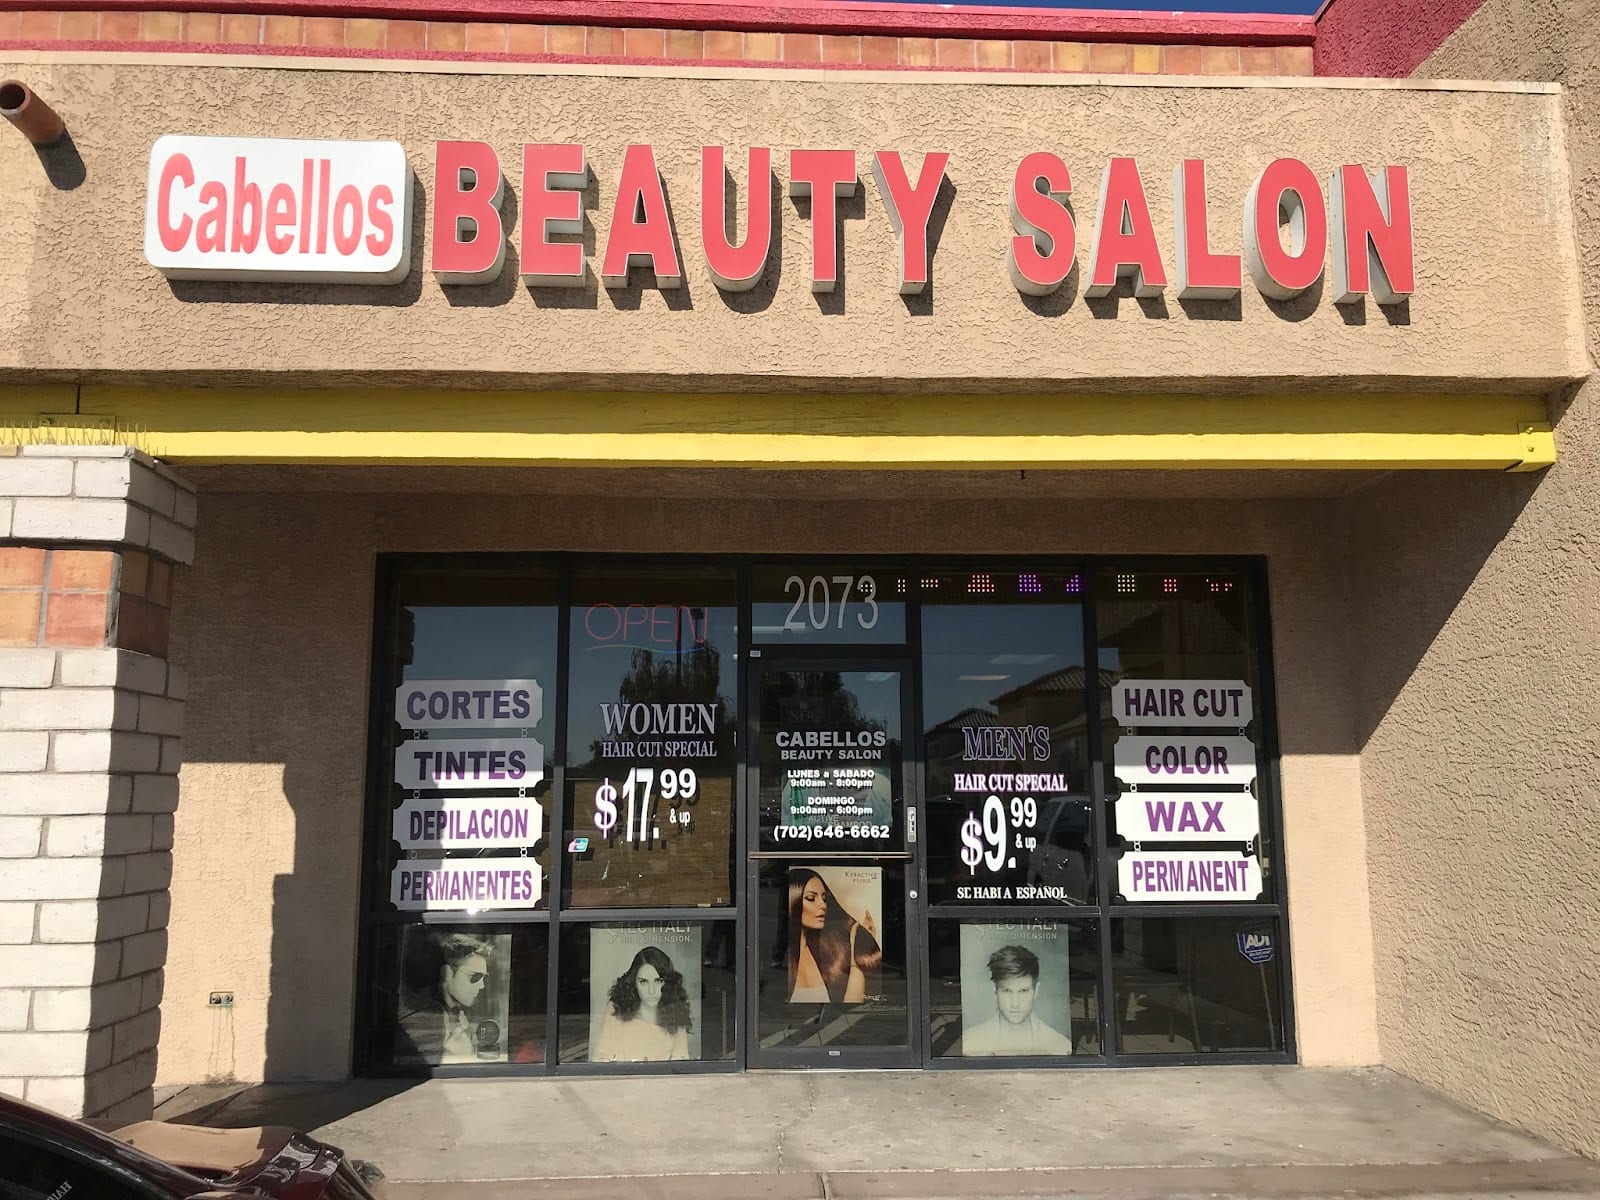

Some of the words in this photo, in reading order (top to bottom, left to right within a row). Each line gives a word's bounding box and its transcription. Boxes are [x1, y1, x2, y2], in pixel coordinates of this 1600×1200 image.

[156, 152, 395, 258] Cabellos
[431, 139, 950, 288] BEAUTY
[1010, 151, 1415, 297] SALON
[784, 575, 879, 630] 2073
[584, 603, 709, 644] OPEN
[406, 690, 531, 721] CORTES
[1124, 688, 1186, 717] HAIR
[1193, 688, 1243, 717] CUT
[600, 703, 718, 735] WOMEN
[602, 741, 635, 758] HAIR
[637, 741, 663, 758] CUT
[664, 741, 717, 758] SPECIAL
[775, 731, 886, 747] CABELLOS
[962, 725, 1050, 762] MEN'S
[413, 750, 526, 781] TINTES
[781, 750, 833, 760] BEAUTY
[838, 750, 881, 760] SALON
[1145, 745, 1229, 775] COLOR
[787, 769, 821, 779] LUNES
[823, 771, 830, 779] a
[833, 769, 875, 779] SABADO
[790, 778, 827, 788] 9:00am
[836, 778, 873, 789] 8:00pm
[953, 773, 987, 792] HAIR
[988, 773, 1013, 792] CUT
[1015, 774, 1068, 792] SPECIAL
[790, 805, 827, 815] 9:00am
[836, 805, 873, 816] 6:00pm
[807, 796, 855, 805] DOMINGO
[409, 808, 529, 841] DEPILACION
[669, 808, 677, 824] &
[679, 811, 691, 827] up
[1145, 801, 1226, 833] WAX
[773, 825, 890, 842] (702)646-6662
[1015, 833, 1023, 849] &
[1025, 836, 1037, 852] up
[400, 869, 533, 901] PERMANENTES
[1132, 860, 1249, 893] PERMANENT
[957, 887, 972, 899] SE
[1016, 885, 1068, 899] ESPAÑOL
